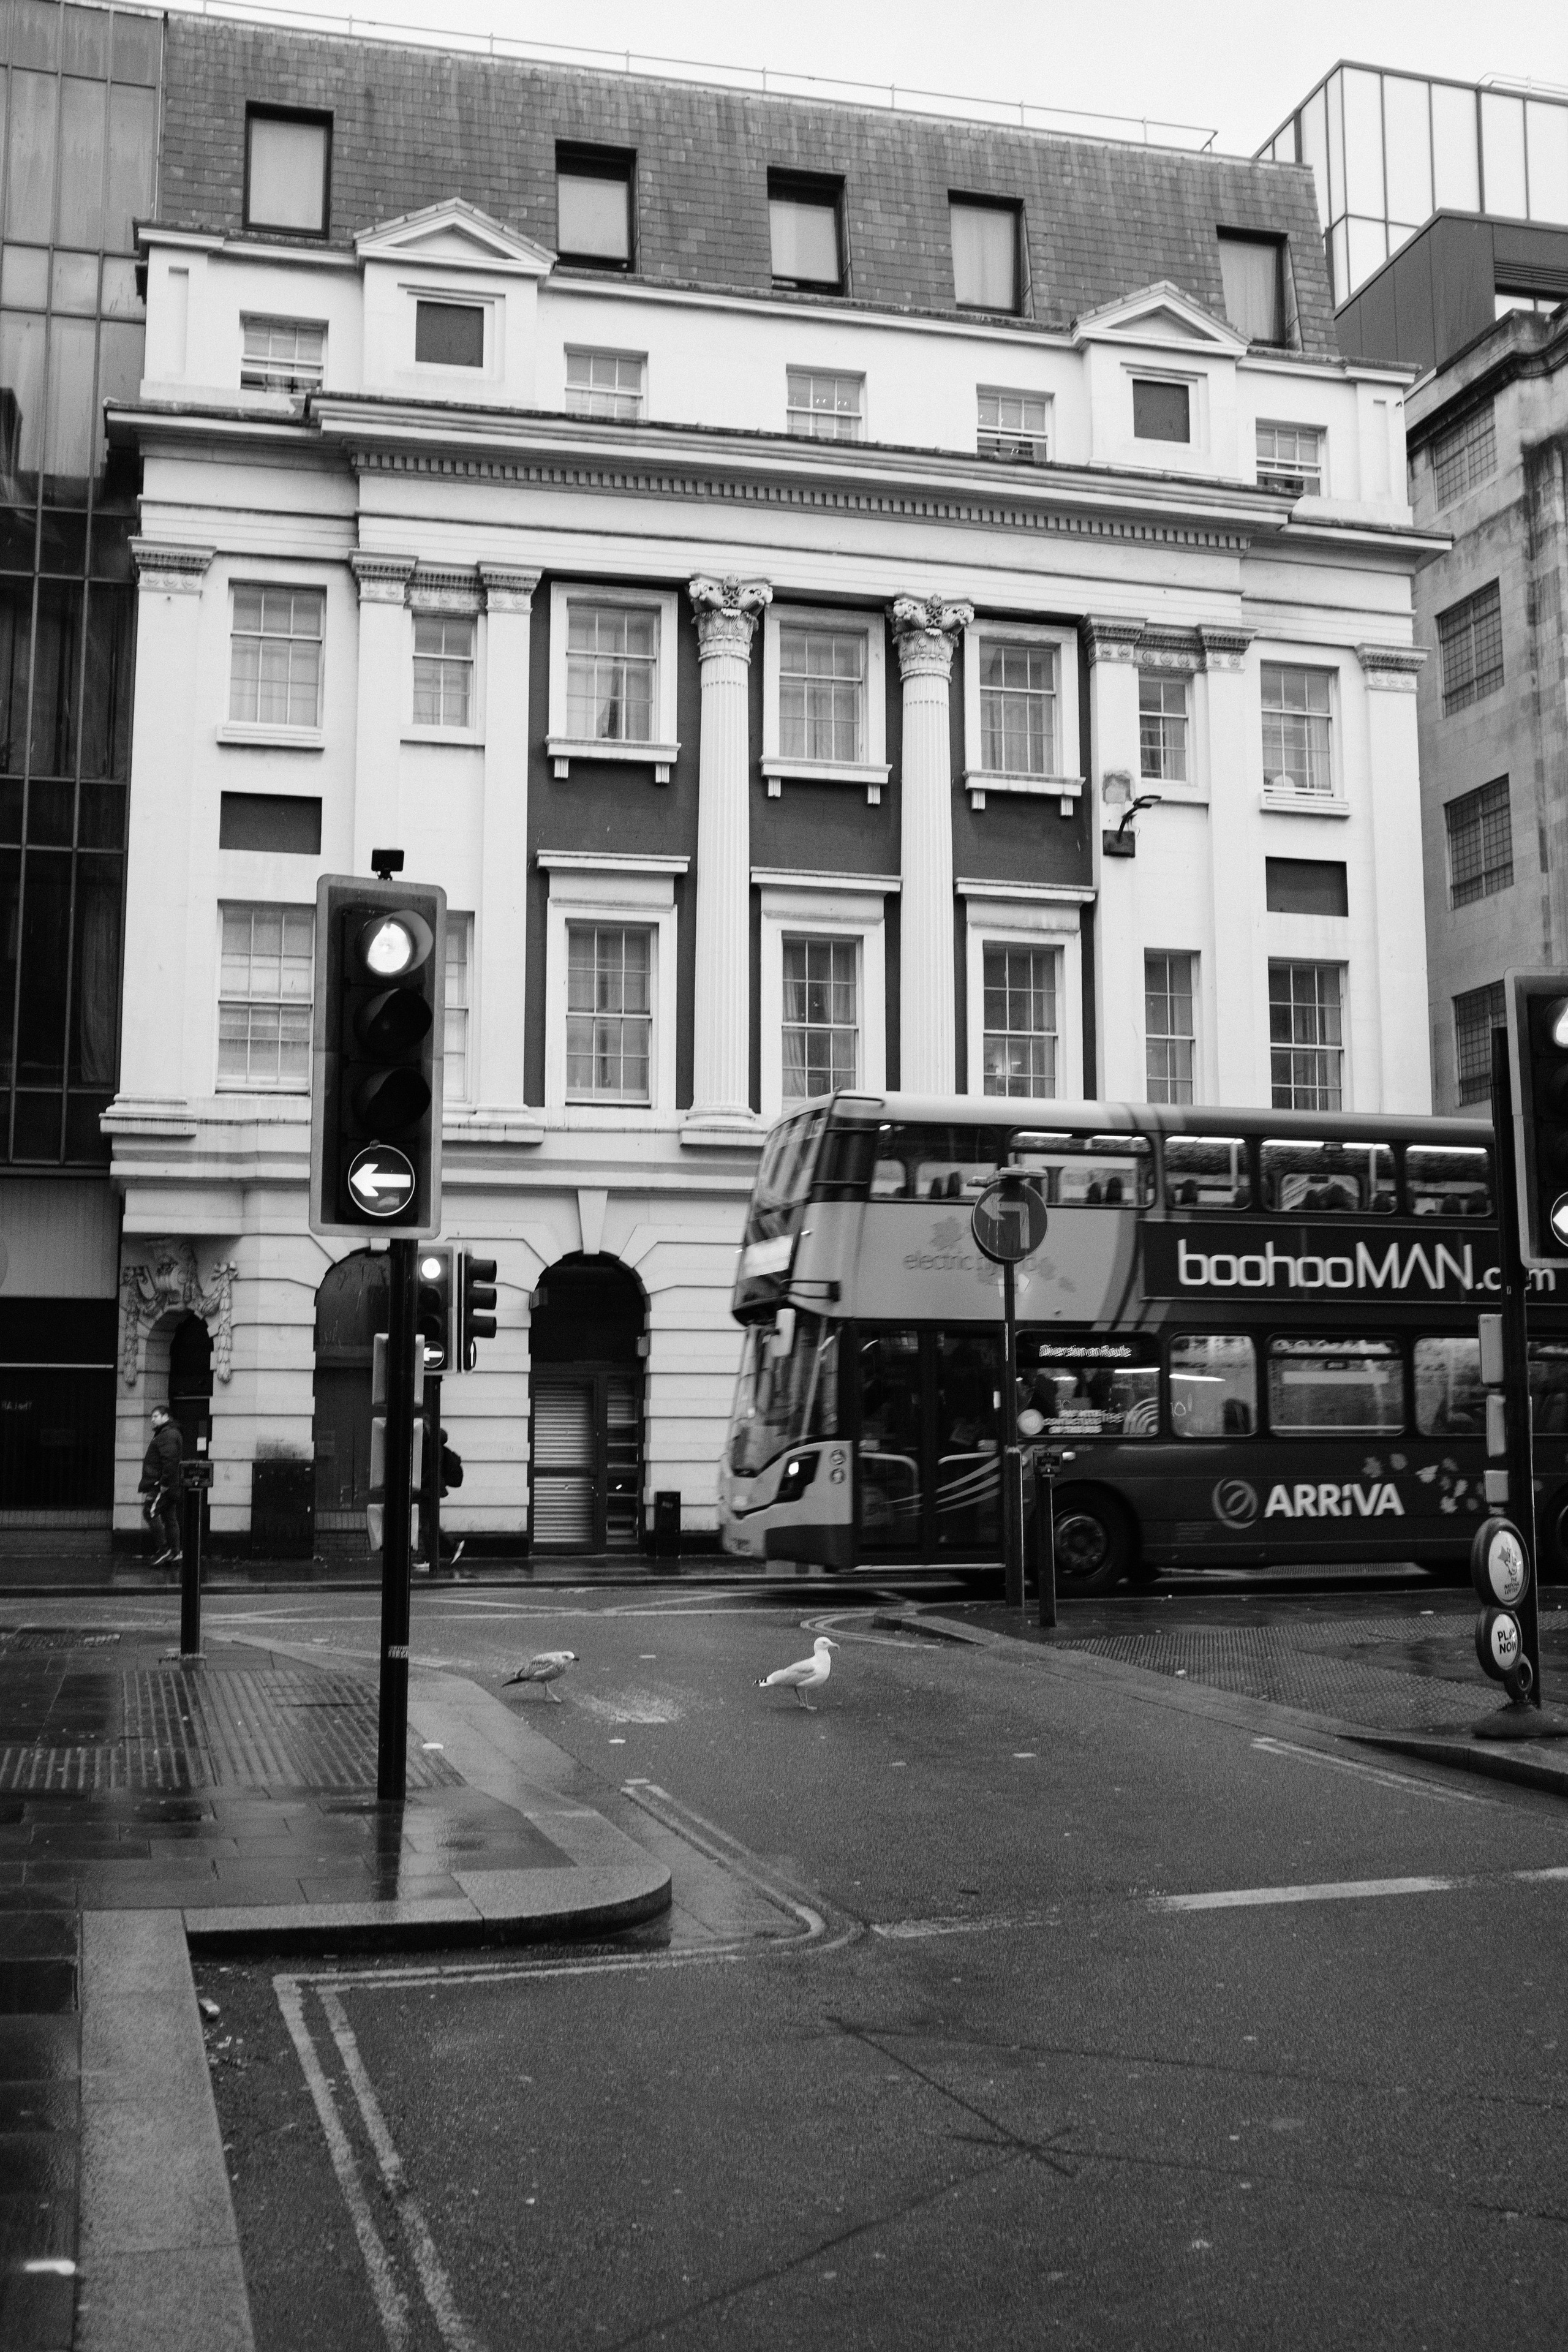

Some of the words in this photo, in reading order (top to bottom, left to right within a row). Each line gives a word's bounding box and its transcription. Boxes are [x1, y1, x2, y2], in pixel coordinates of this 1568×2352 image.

[1178, 1238, 1556, 1291] boohooMAN.cm
[1497, 1627, 1515, 1642] PLAY
[1499, 1640, 1517, 1654] NOW
